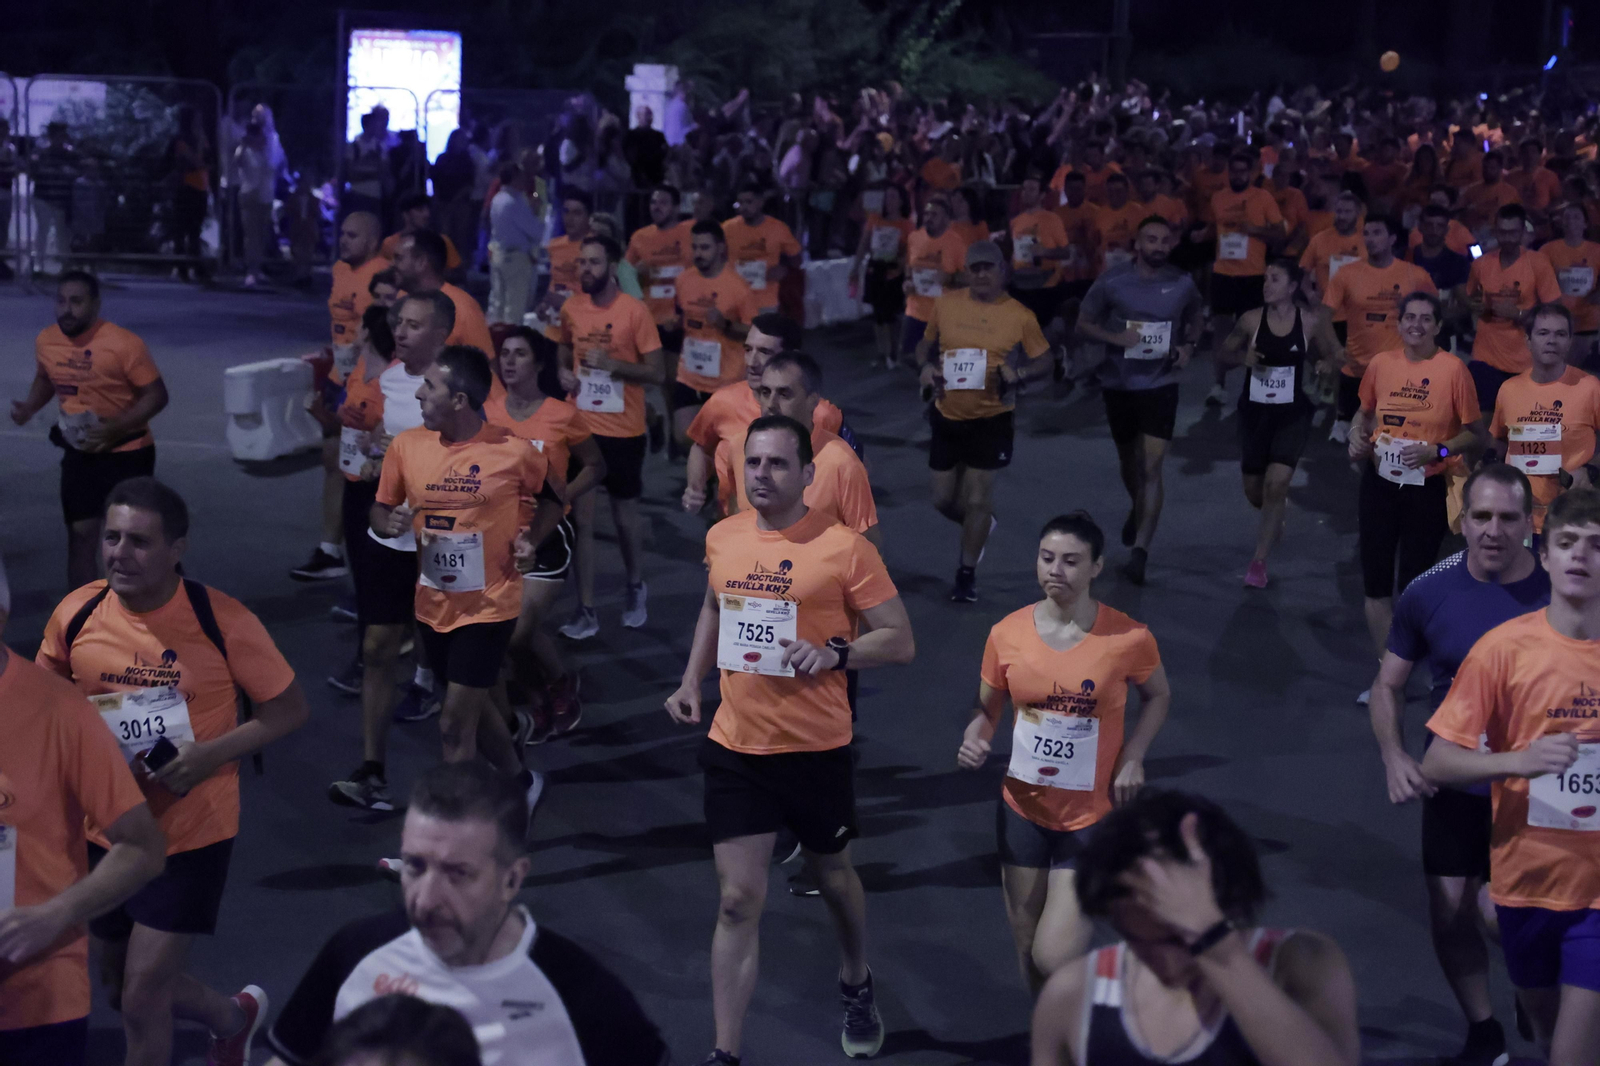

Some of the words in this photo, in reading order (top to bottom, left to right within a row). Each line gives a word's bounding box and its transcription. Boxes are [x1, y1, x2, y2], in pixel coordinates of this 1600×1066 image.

[1139, 335, 1163, 344] 4235
[953, 362, 975, 373] 7477
[587, 382, 611, 395] 7360
[1259, 378, 1286, 389] 14238
[1389, 391, 1412, 399] SEVILLA
[1401, 387, 1430, 395] NOCTURNA
[1529, 410, 1564, 418] NOCTURNA
[1520, 441, 1547, 454] 1123
[443, 477, 482, 486] NOCTURNA
[425, 484, 459, 492] SEVILLA
[459, 485, 480, 494] KH7
[434, 552, 465, 567] 4181
[746, 573, 793, 585] NOCTURNA
[725, 580, 765, 591] SEVILLA
[765, 584, 790, 594] KH7
[738, 621, 774, 643] 7525
[125, 666, 181, 679] NOCTURNA
[100, 672, 149, 687] SEVILLA
[1046, 694, 1098, 706] NOCTURNA
[1069, 705, 1095, 716] KH7
[1546, 708, 1598, 719] SEVILLA
[119, 715, 166, 740] 3013
[1034, 735, 1074, 759] 7523
